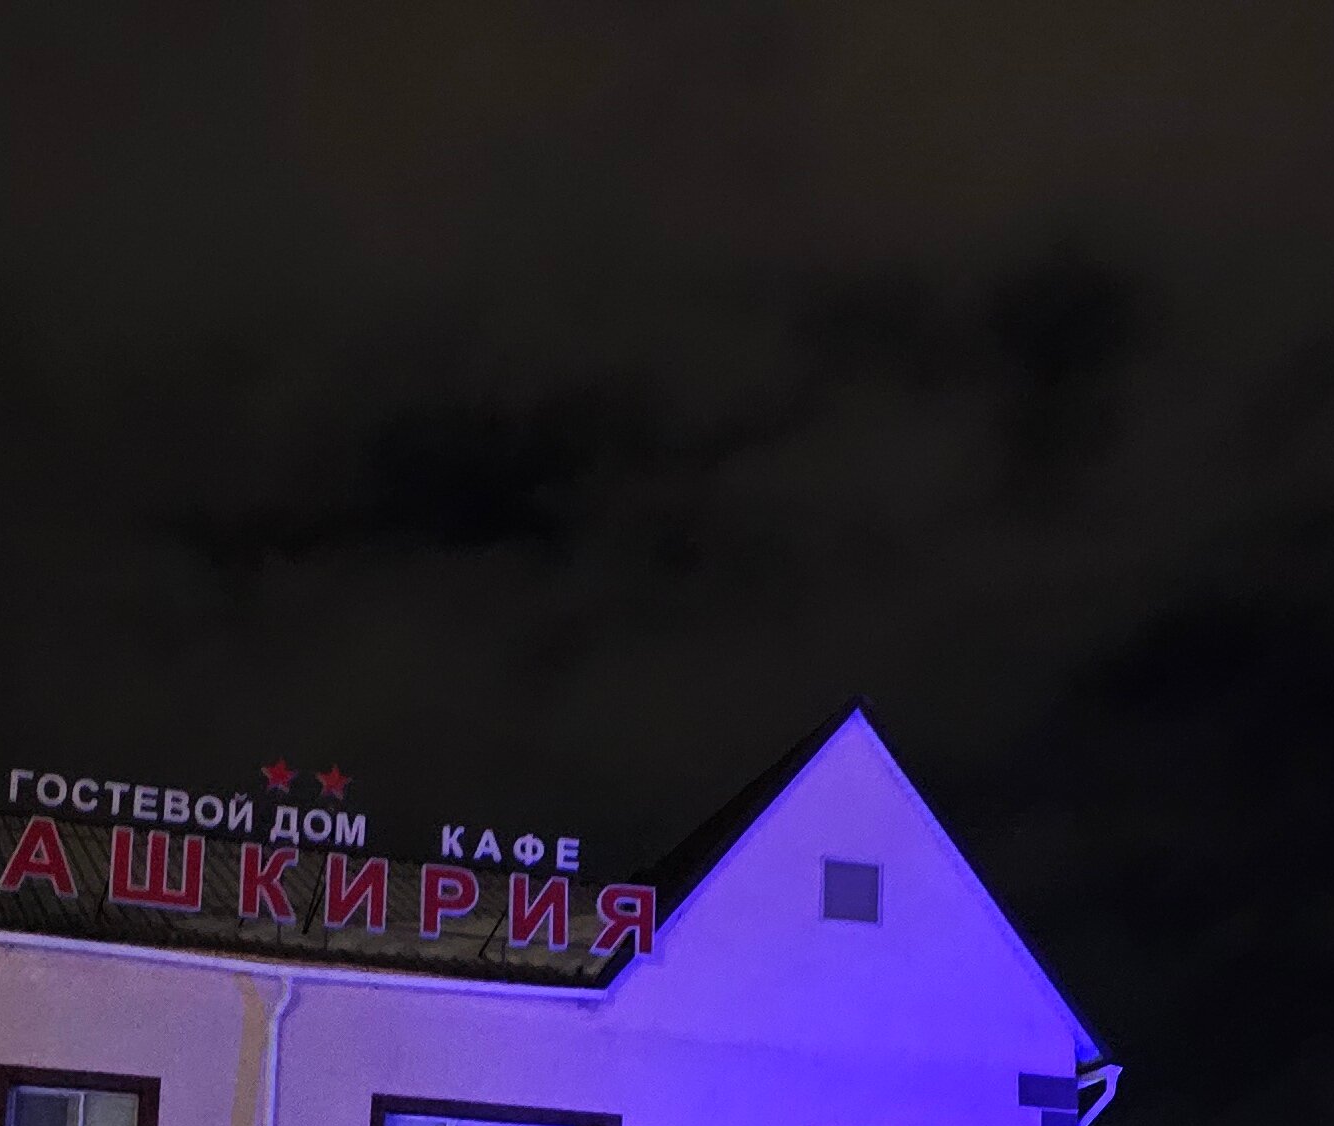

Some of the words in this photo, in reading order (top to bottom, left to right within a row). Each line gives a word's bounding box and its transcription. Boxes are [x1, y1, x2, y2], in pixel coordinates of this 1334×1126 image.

[9, 768, 254, 833] ГОСТЕВОЙ
[269, 805, 366, 847] ДОМ
[440, 824, 581, 871] КАФЕ
